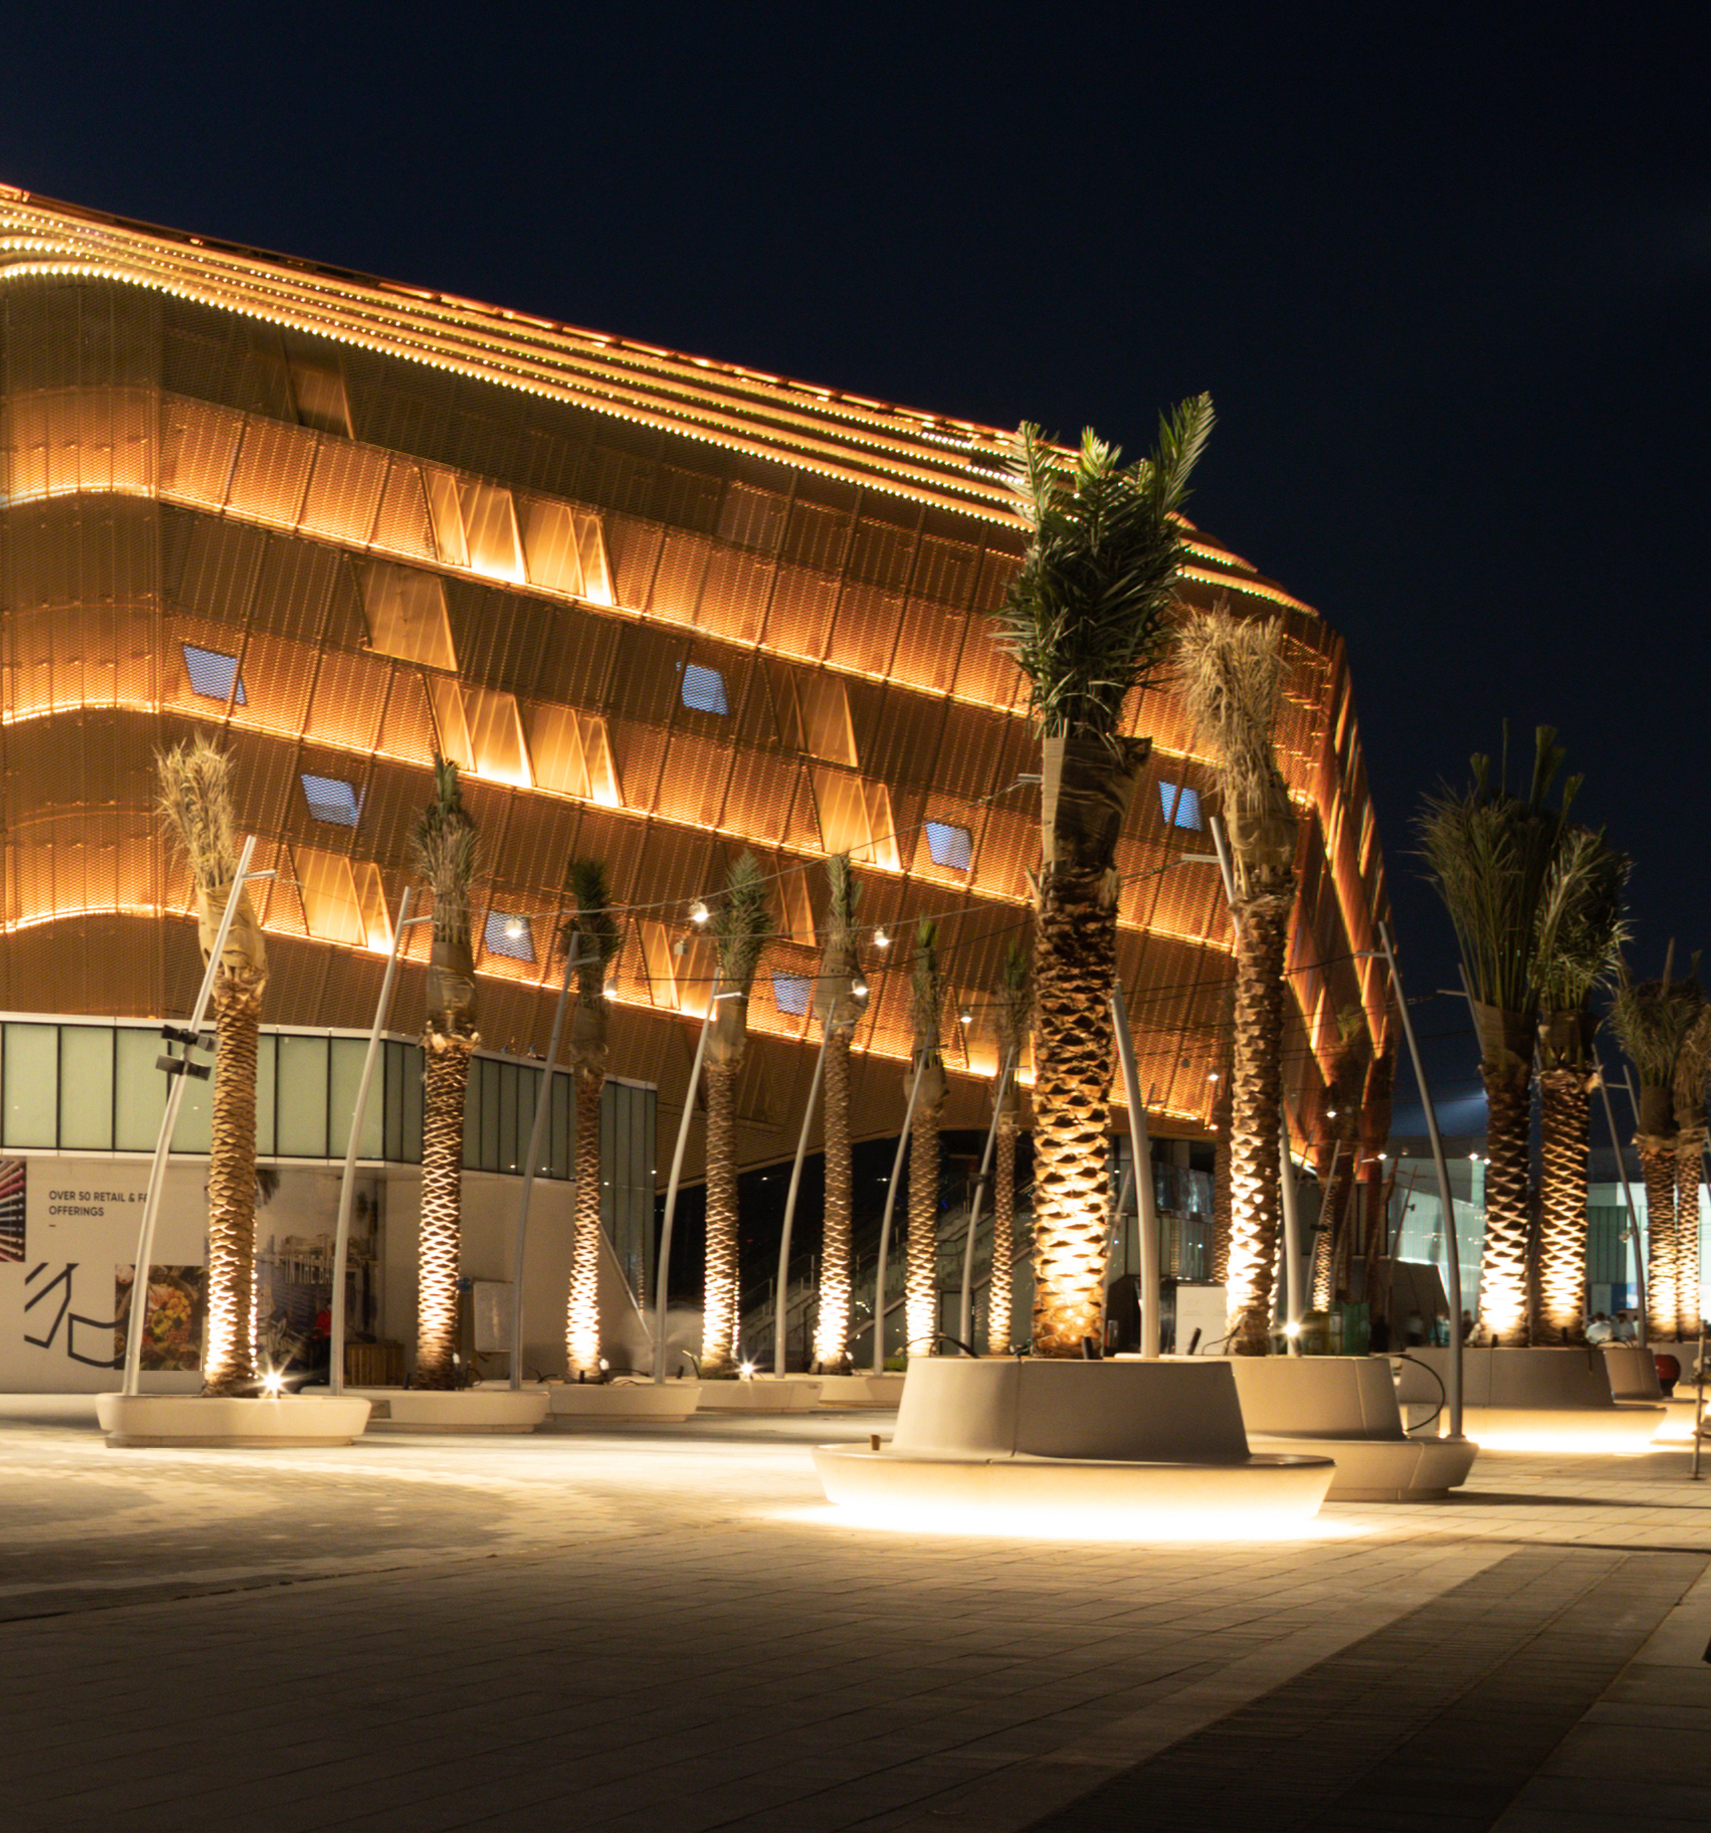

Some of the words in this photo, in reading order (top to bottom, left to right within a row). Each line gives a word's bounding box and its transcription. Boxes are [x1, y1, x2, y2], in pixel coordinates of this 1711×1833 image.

[49, 1191, 76, 1200] OVER
[79, 1191, 91, 1201] 50
[94, 1192, 125, 1202] RETAIL
[128, 1193, 135, 1202] &
[49, 1206, 104, 1216] OFFERINGS
